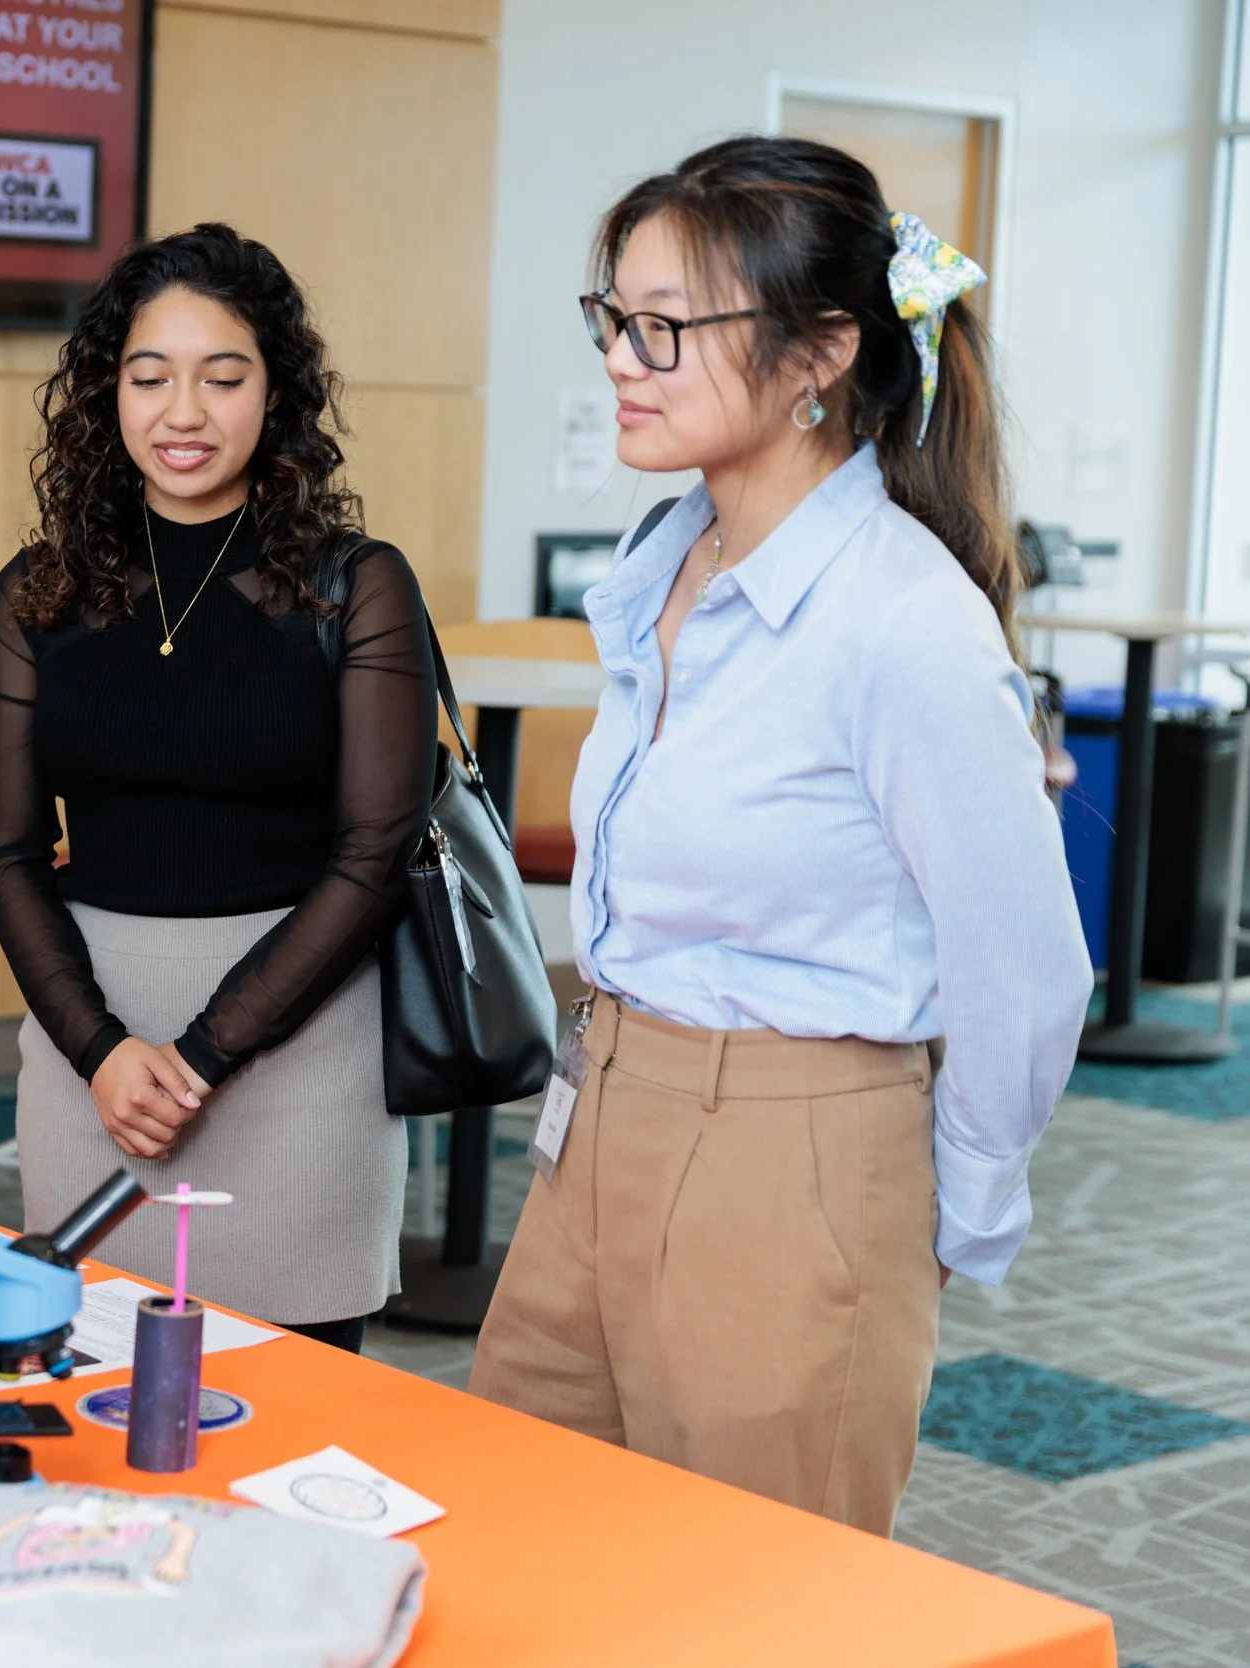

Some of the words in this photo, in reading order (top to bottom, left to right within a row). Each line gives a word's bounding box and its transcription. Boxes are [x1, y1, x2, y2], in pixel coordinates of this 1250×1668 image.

[38, 18, 122, 52] YOUR
[2, 177, 38, 198] ON
[46, 180, 61, 198] A
